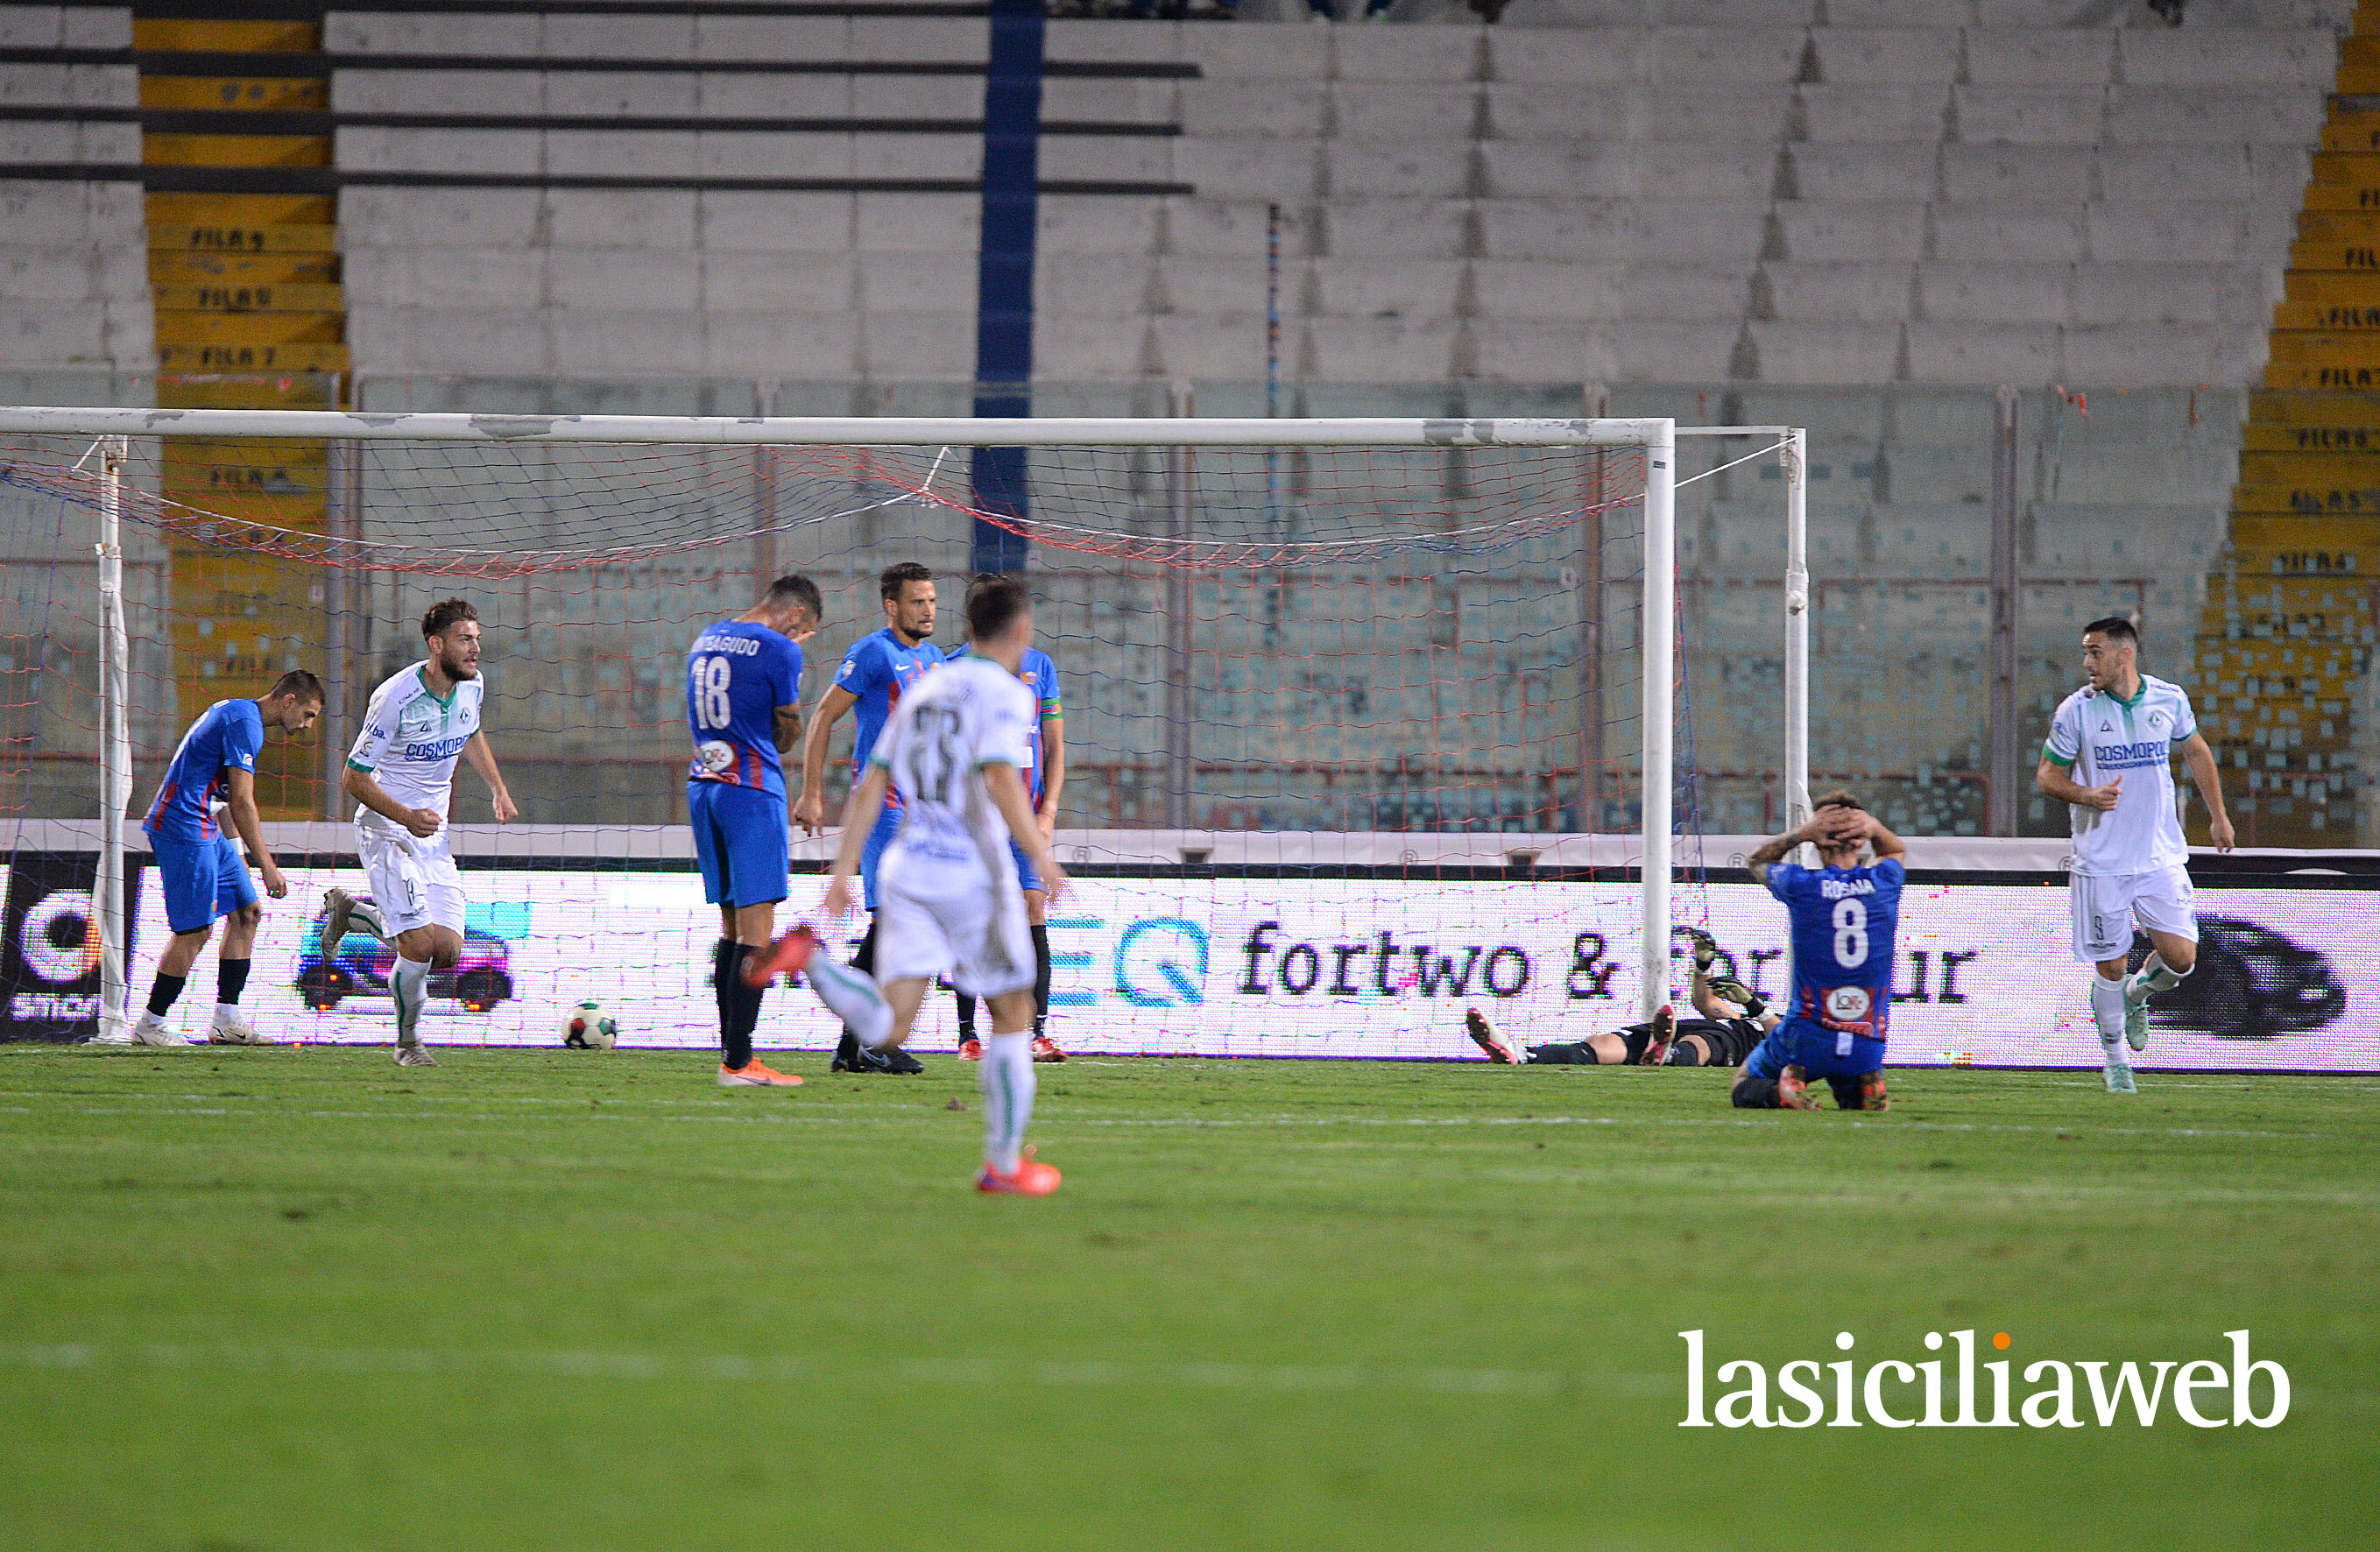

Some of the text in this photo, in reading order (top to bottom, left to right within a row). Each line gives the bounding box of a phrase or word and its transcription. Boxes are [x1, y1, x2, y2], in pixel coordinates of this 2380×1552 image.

[191, 229, 244, 247] FILA
[199, 287, 251, 307] FILA
[201, 347, 254, 365] FILA
[2320, 368, 2372, 387] FILA
[692, 655, 731, 730] 18
[1821, 878, 1876, 899] ROSAIA
[1832, 898, 1869, 970] 8
[1045, 916, 1211, 1007] EQ
[1236, 920, 1531, 998] fortwo
[1565, 933, 1621, 999] &
